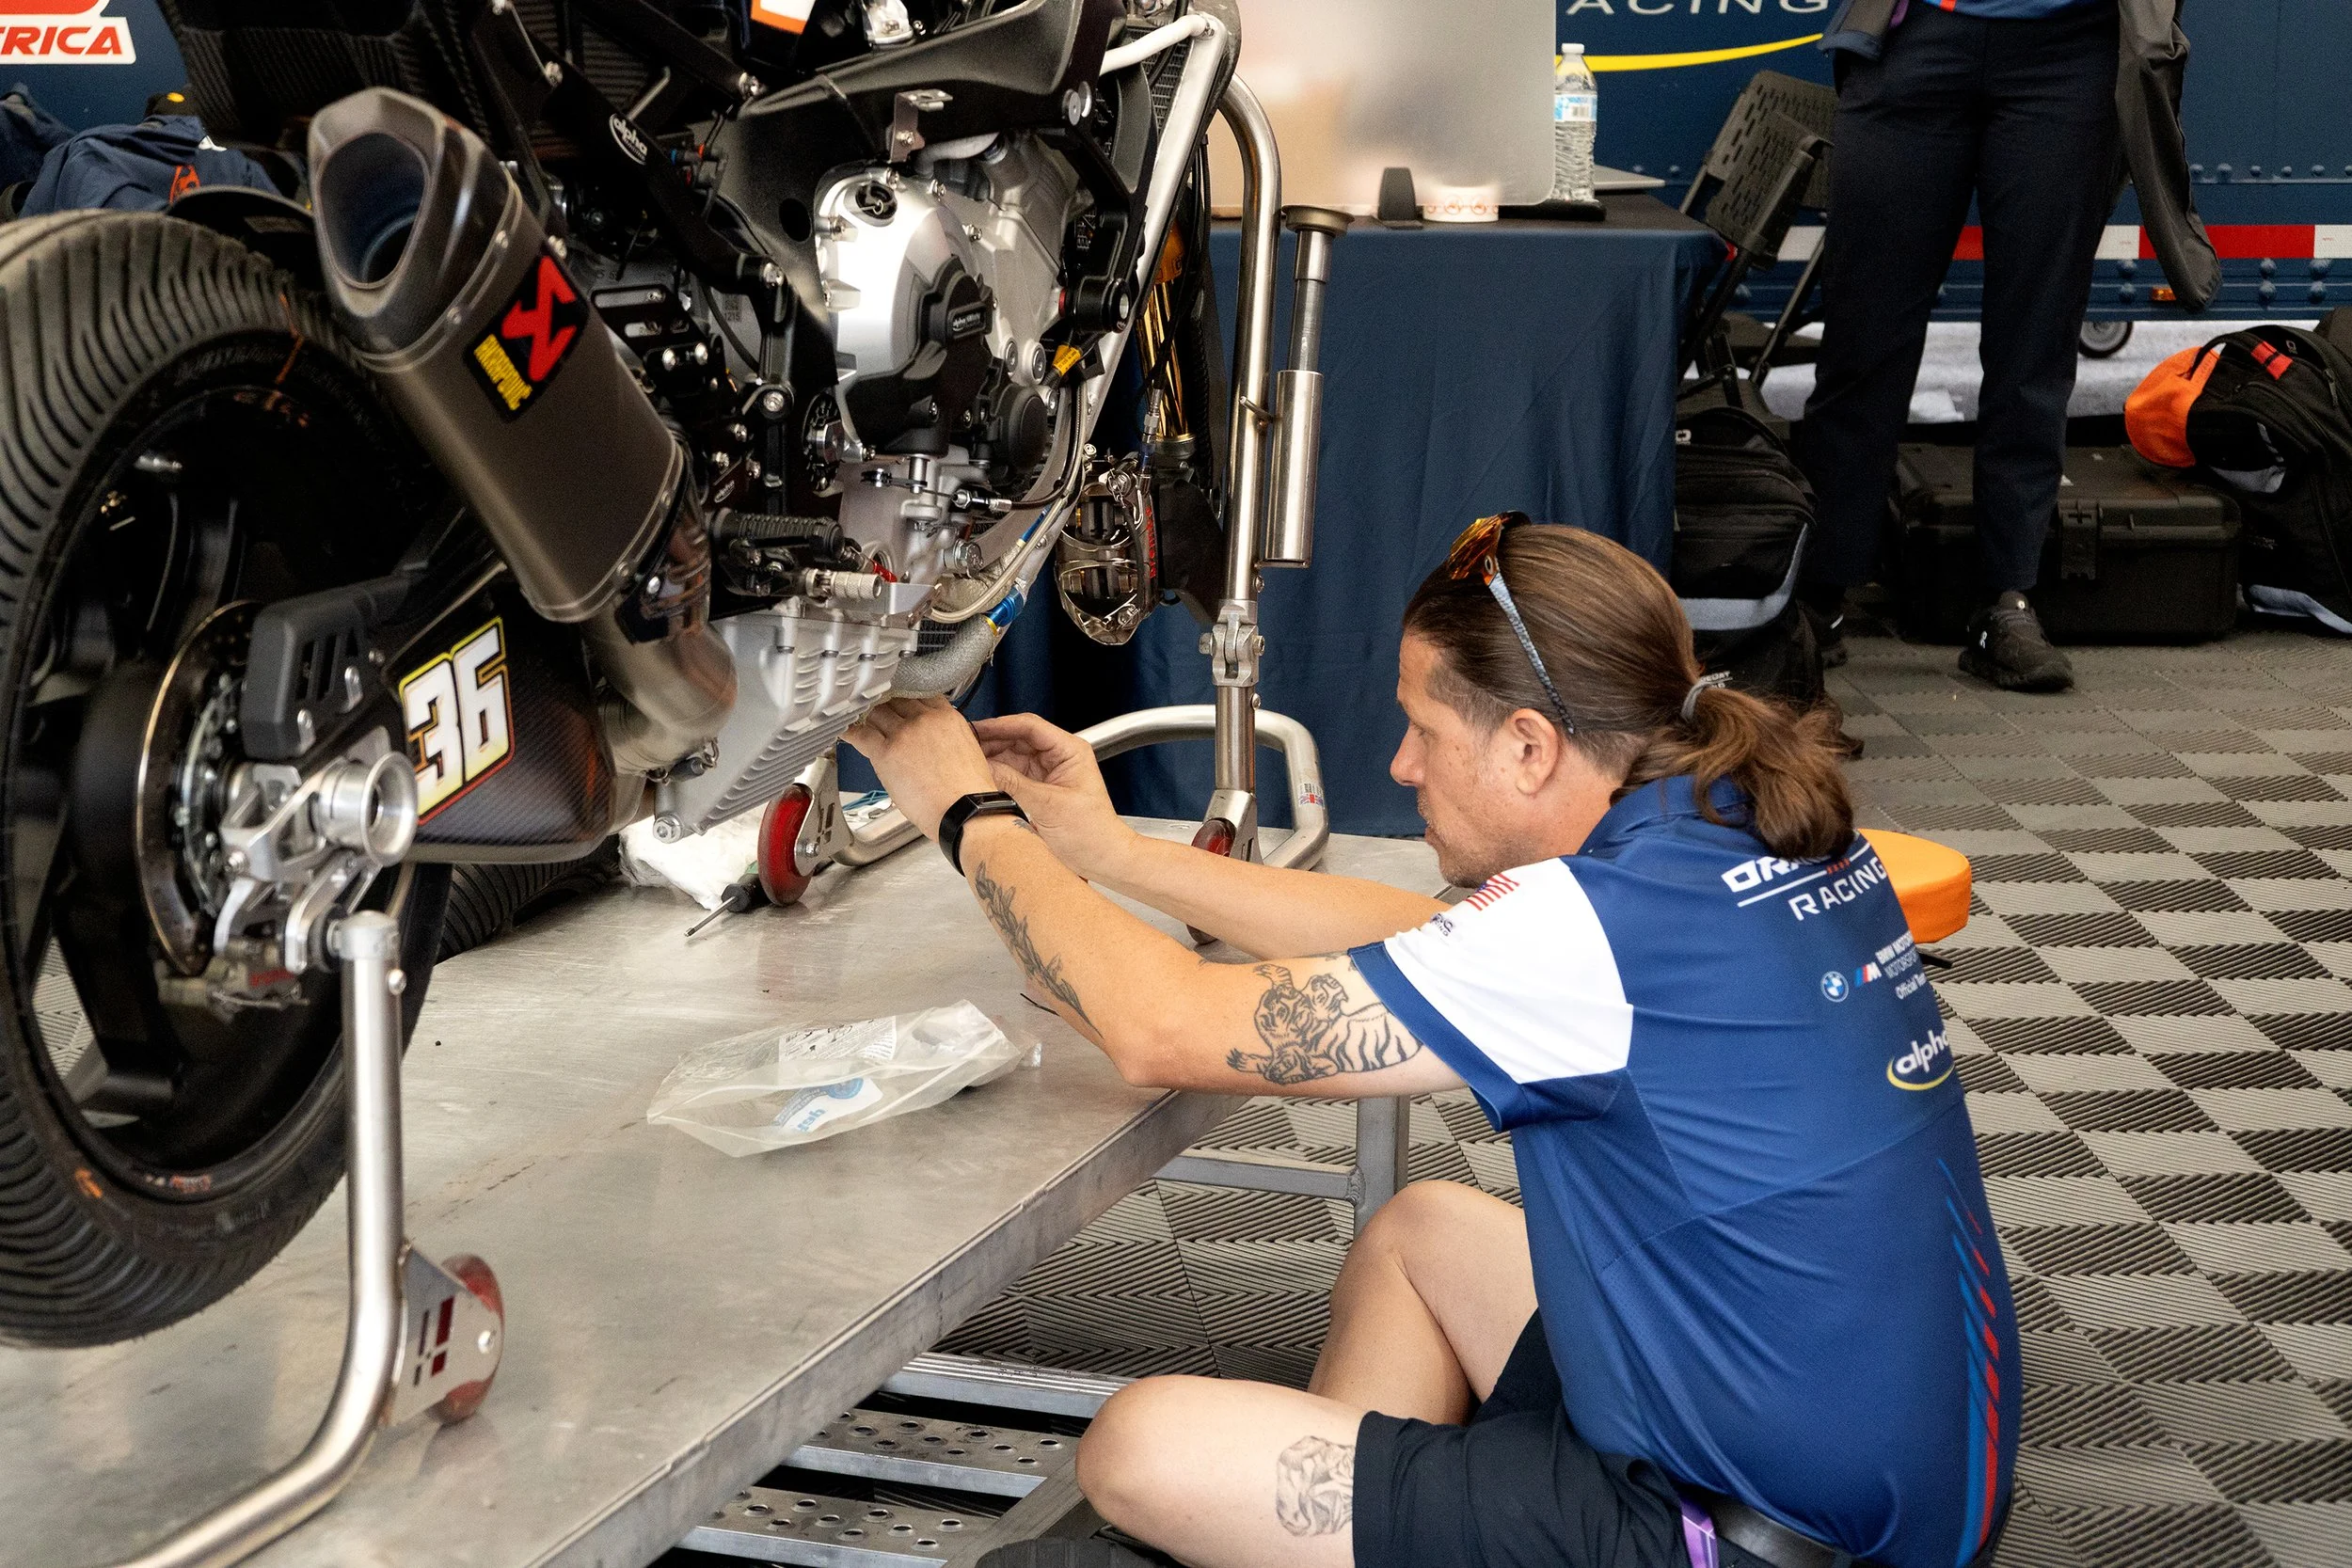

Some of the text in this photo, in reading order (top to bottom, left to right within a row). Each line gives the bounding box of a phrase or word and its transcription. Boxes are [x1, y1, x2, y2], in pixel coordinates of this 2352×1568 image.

[0, 26, 122, 55] RICA
[613, 118, 648, 156] alpha
[402, 623, 512, 818] 36
[1788, 856, 1888, 921] RACING
